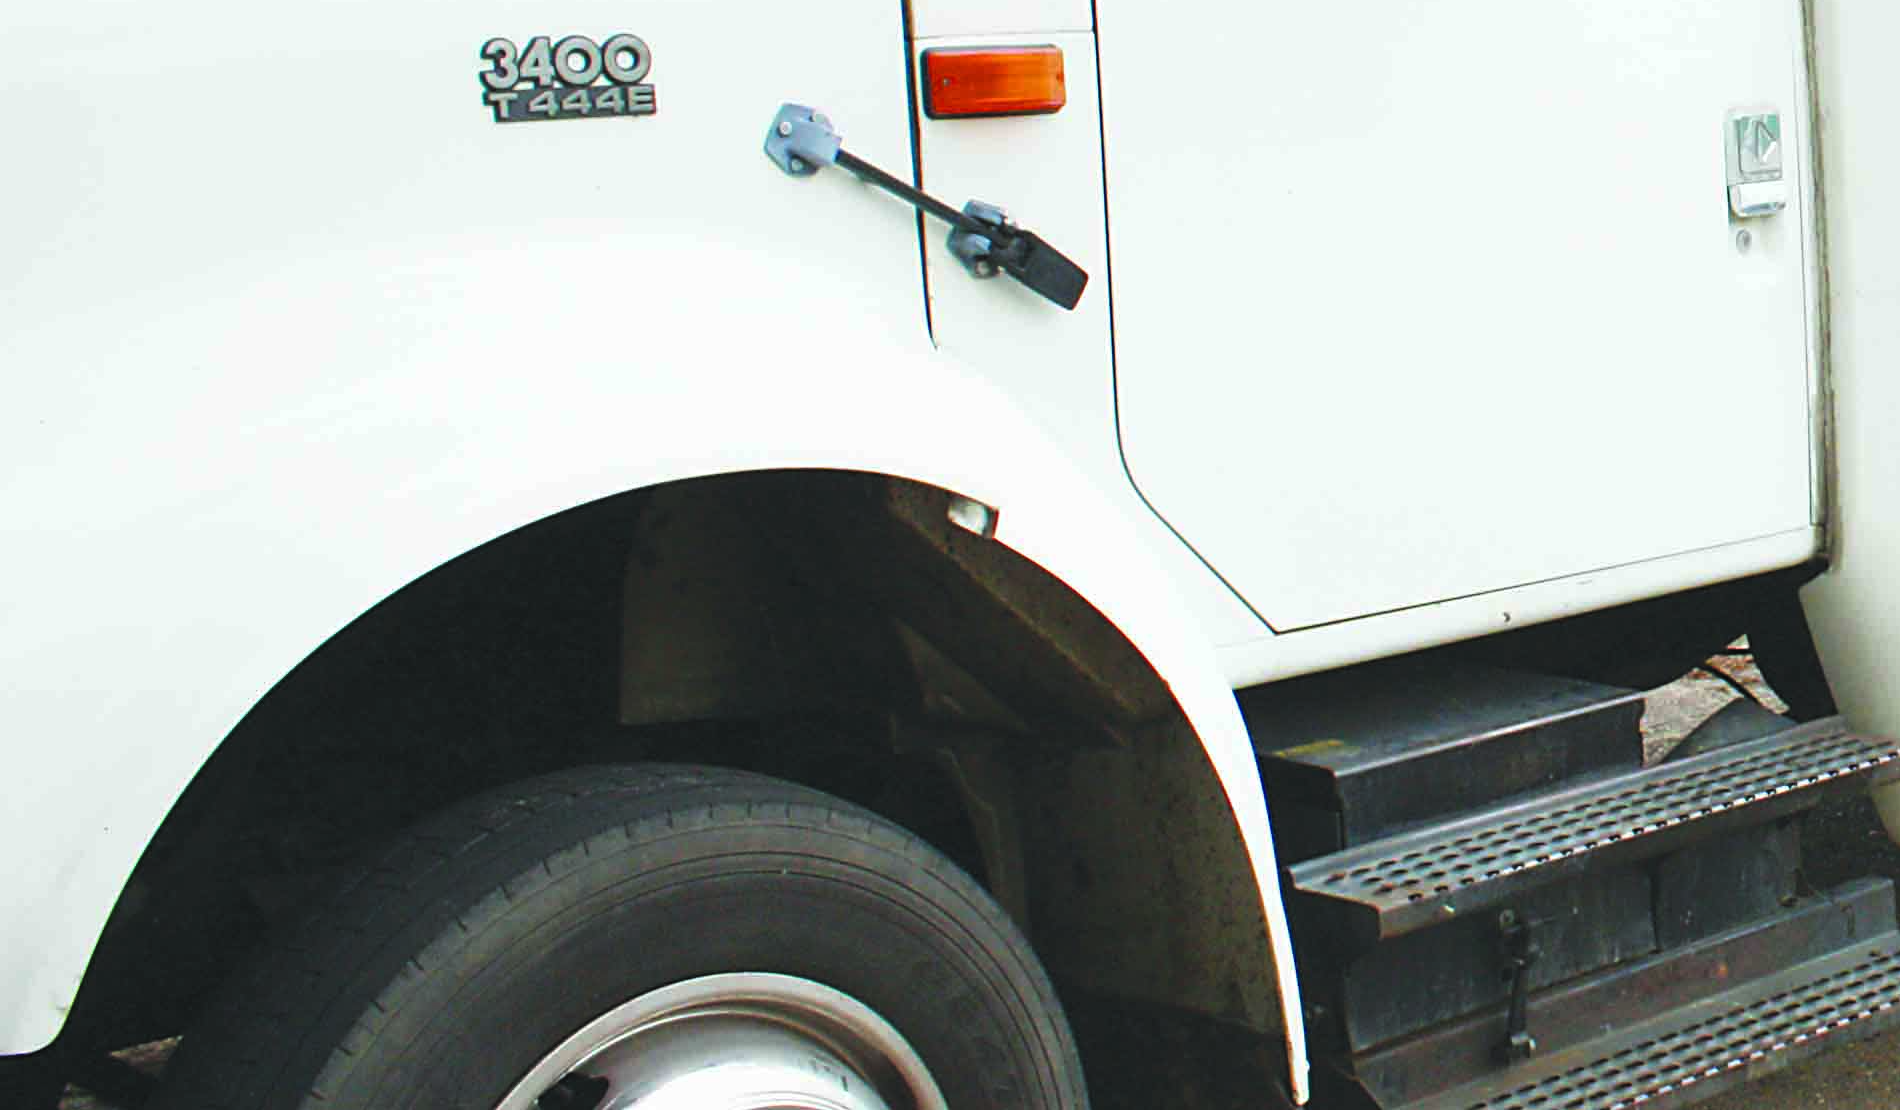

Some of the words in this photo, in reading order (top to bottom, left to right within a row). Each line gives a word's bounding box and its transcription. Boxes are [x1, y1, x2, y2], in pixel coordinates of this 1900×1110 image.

[480, 33, 652, 91] 3400
[488, 92, 519, 119] T
[528, 84, 655, 117] 444E
